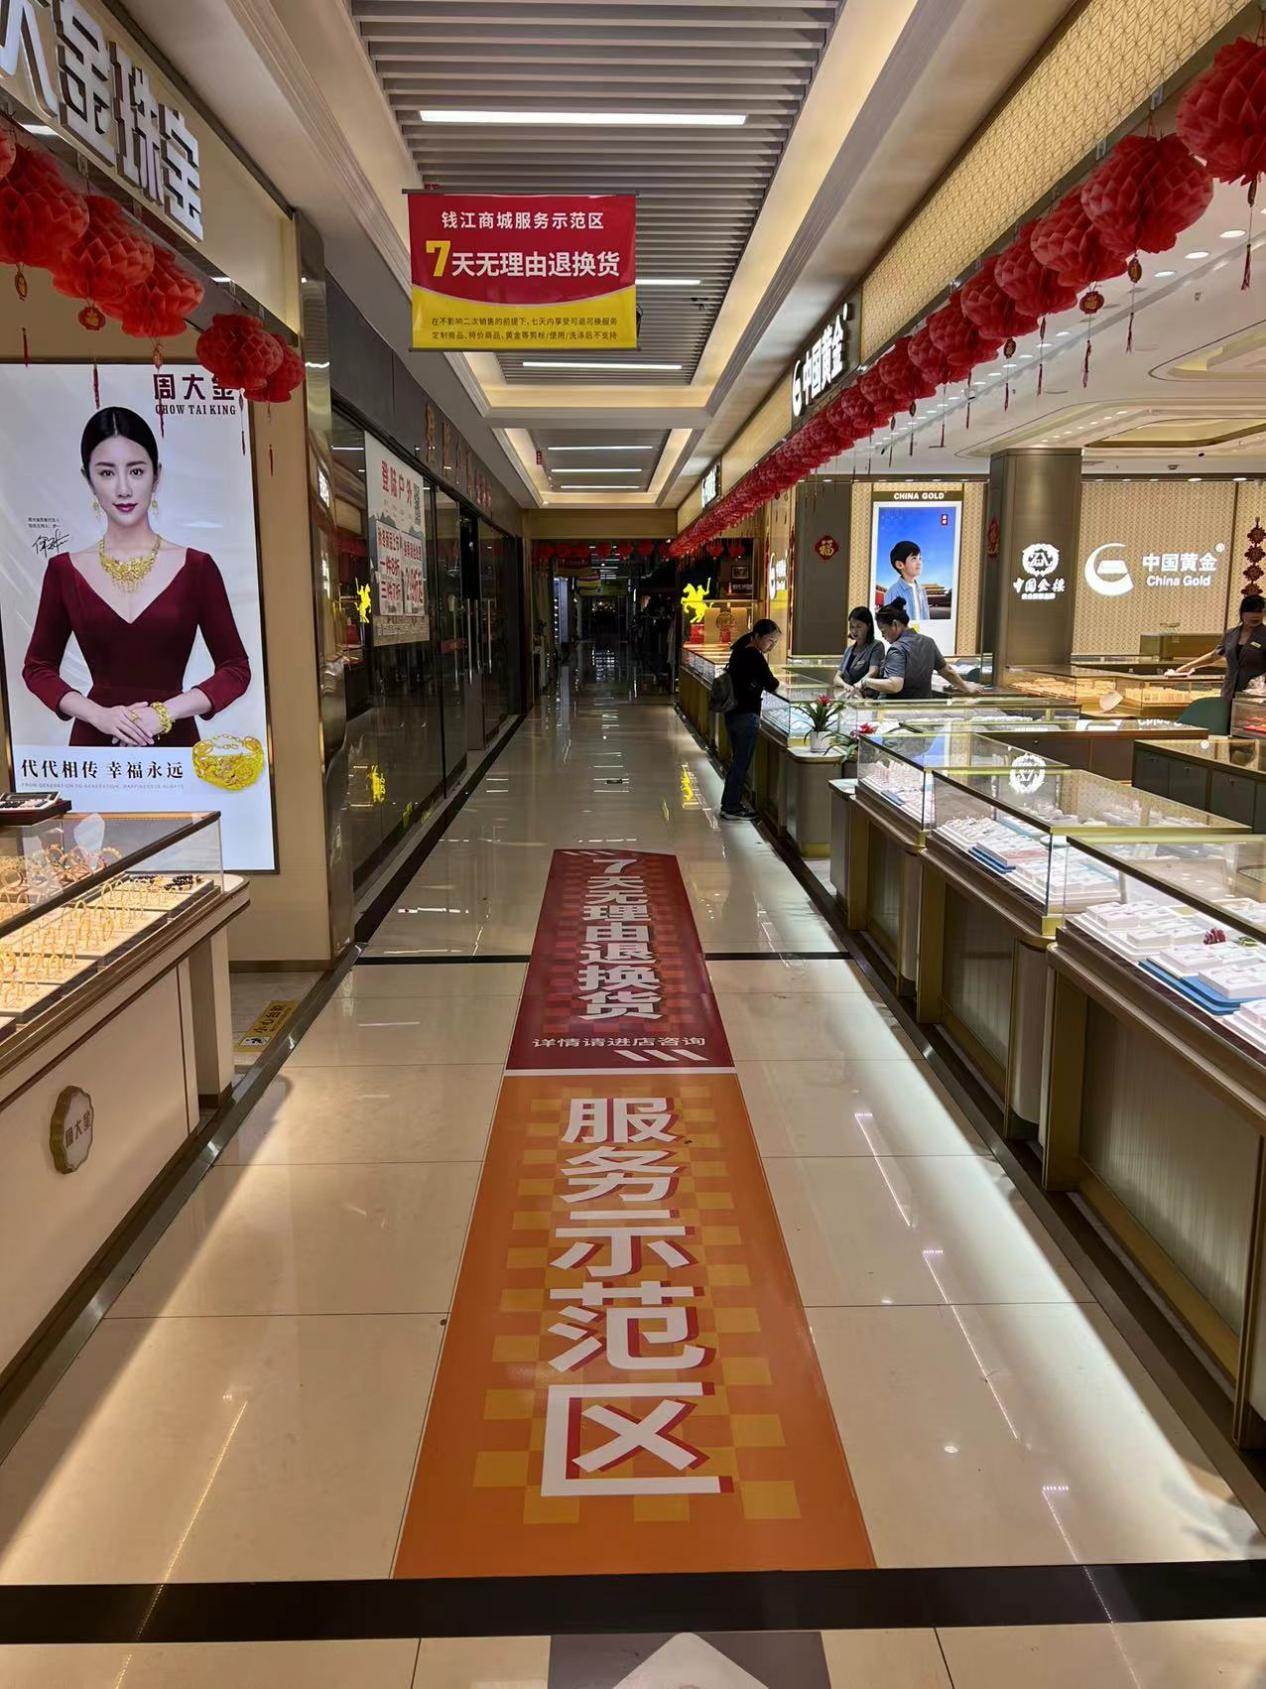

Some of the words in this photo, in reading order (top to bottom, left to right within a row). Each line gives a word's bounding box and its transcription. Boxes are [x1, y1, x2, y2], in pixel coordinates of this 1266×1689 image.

[441, 211, 604, 230] 钱江商城服务示范区
[425, 240, 620, 278] 7天无理由退换货
[155, 404, 186, 415] CHOW
[187, 404, 207, 415] TAI
[209, 404, 236, 415] KING
[893, 492, 920, 500] CHINA
[921, 492, 945, 500] GOLD
[1142, 552, 1217, 572] 中国黄金
[1146, 575, 1180, 586] China
[1182, 575, 1211, 586] Gold
[21, 759, 98, 779] 代代相传
[107, 761, 184, 779] 幸福永远
[577, 859, 662, 1020] 7天无理由退换货
[532, 1037, 706, 1047] 详情请进店咨询
[541, 1097, 724, 1496] 服务示范区
